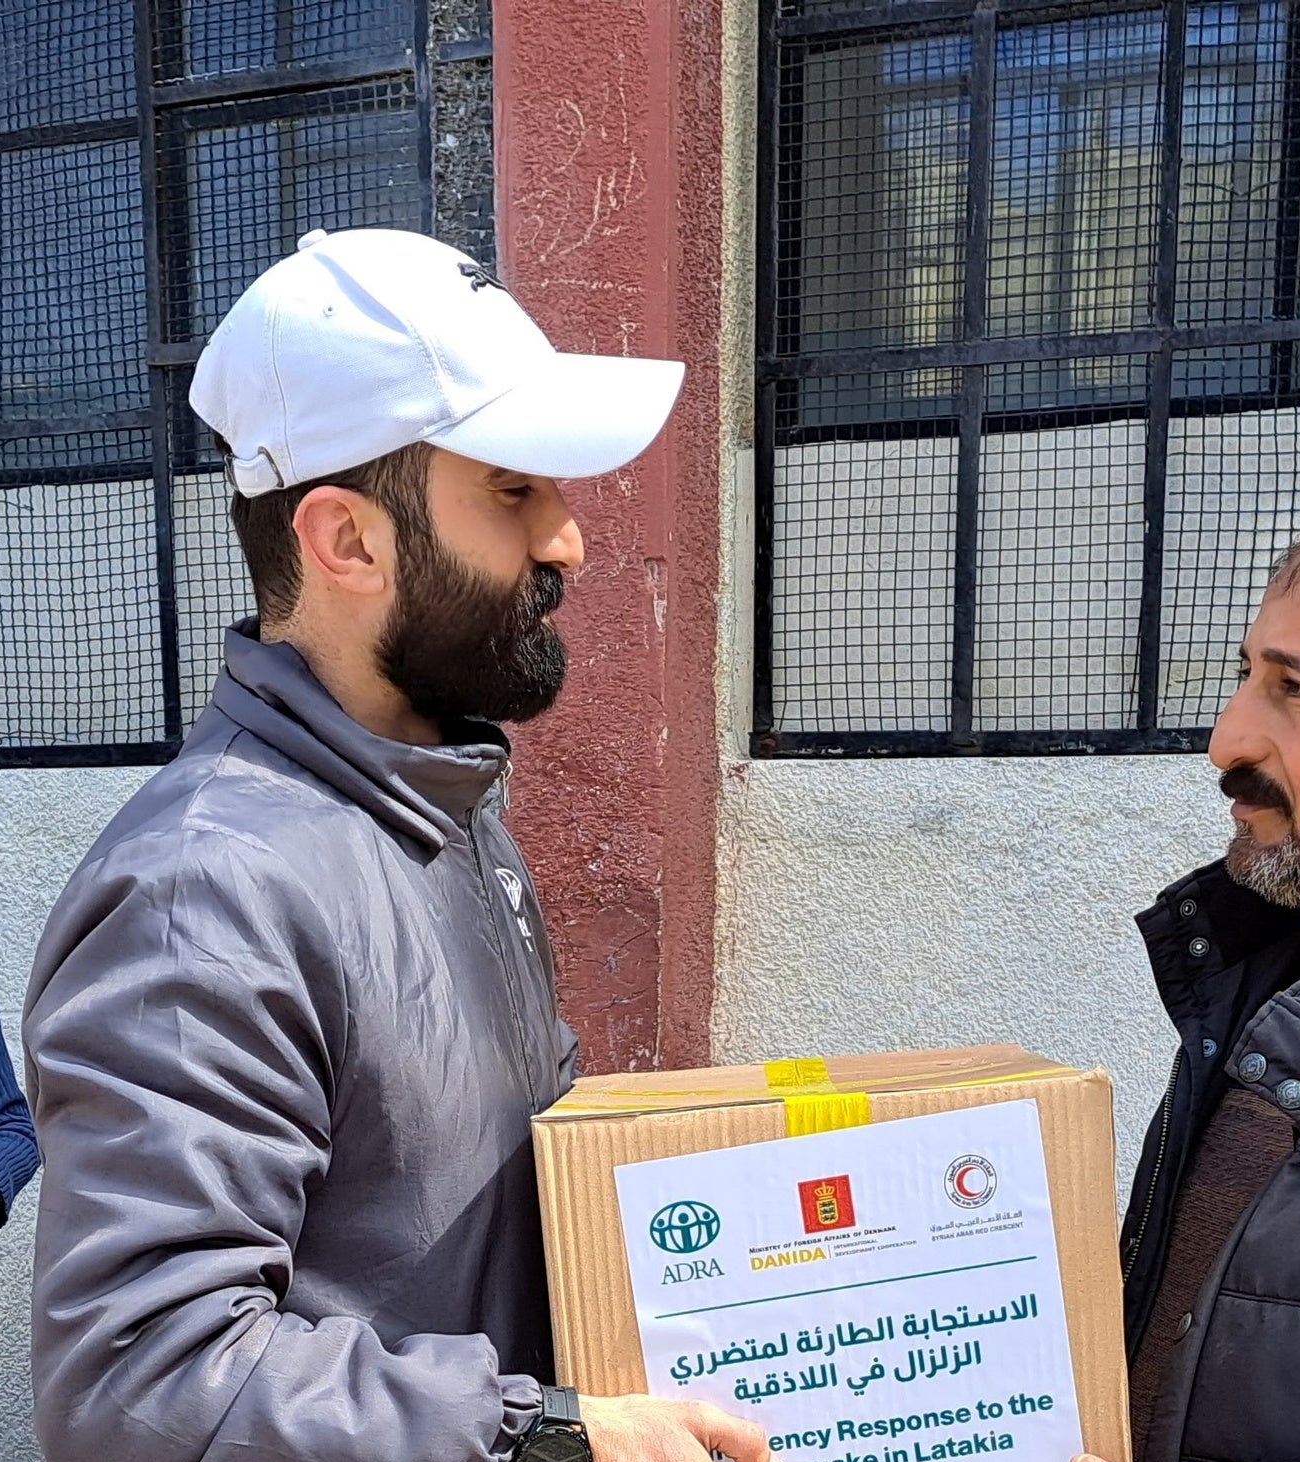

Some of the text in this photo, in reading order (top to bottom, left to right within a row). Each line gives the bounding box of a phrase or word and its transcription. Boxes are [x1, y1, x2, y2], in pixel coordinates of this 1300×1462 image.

[661, 1258, 725, 1285] ADRA
[750, 1246, 827, 1272] DANIDA
[669, 1293, 1039, 1386] الاستجابة الطارئة لمتضرري
[734, 1340, 982, 1405] الزلزال في اللاذقية
[837, 1404, 972, 1442] Response
[976, 1401, 1004, 1421] to
[1008, 1392, 1055, 1416] the
